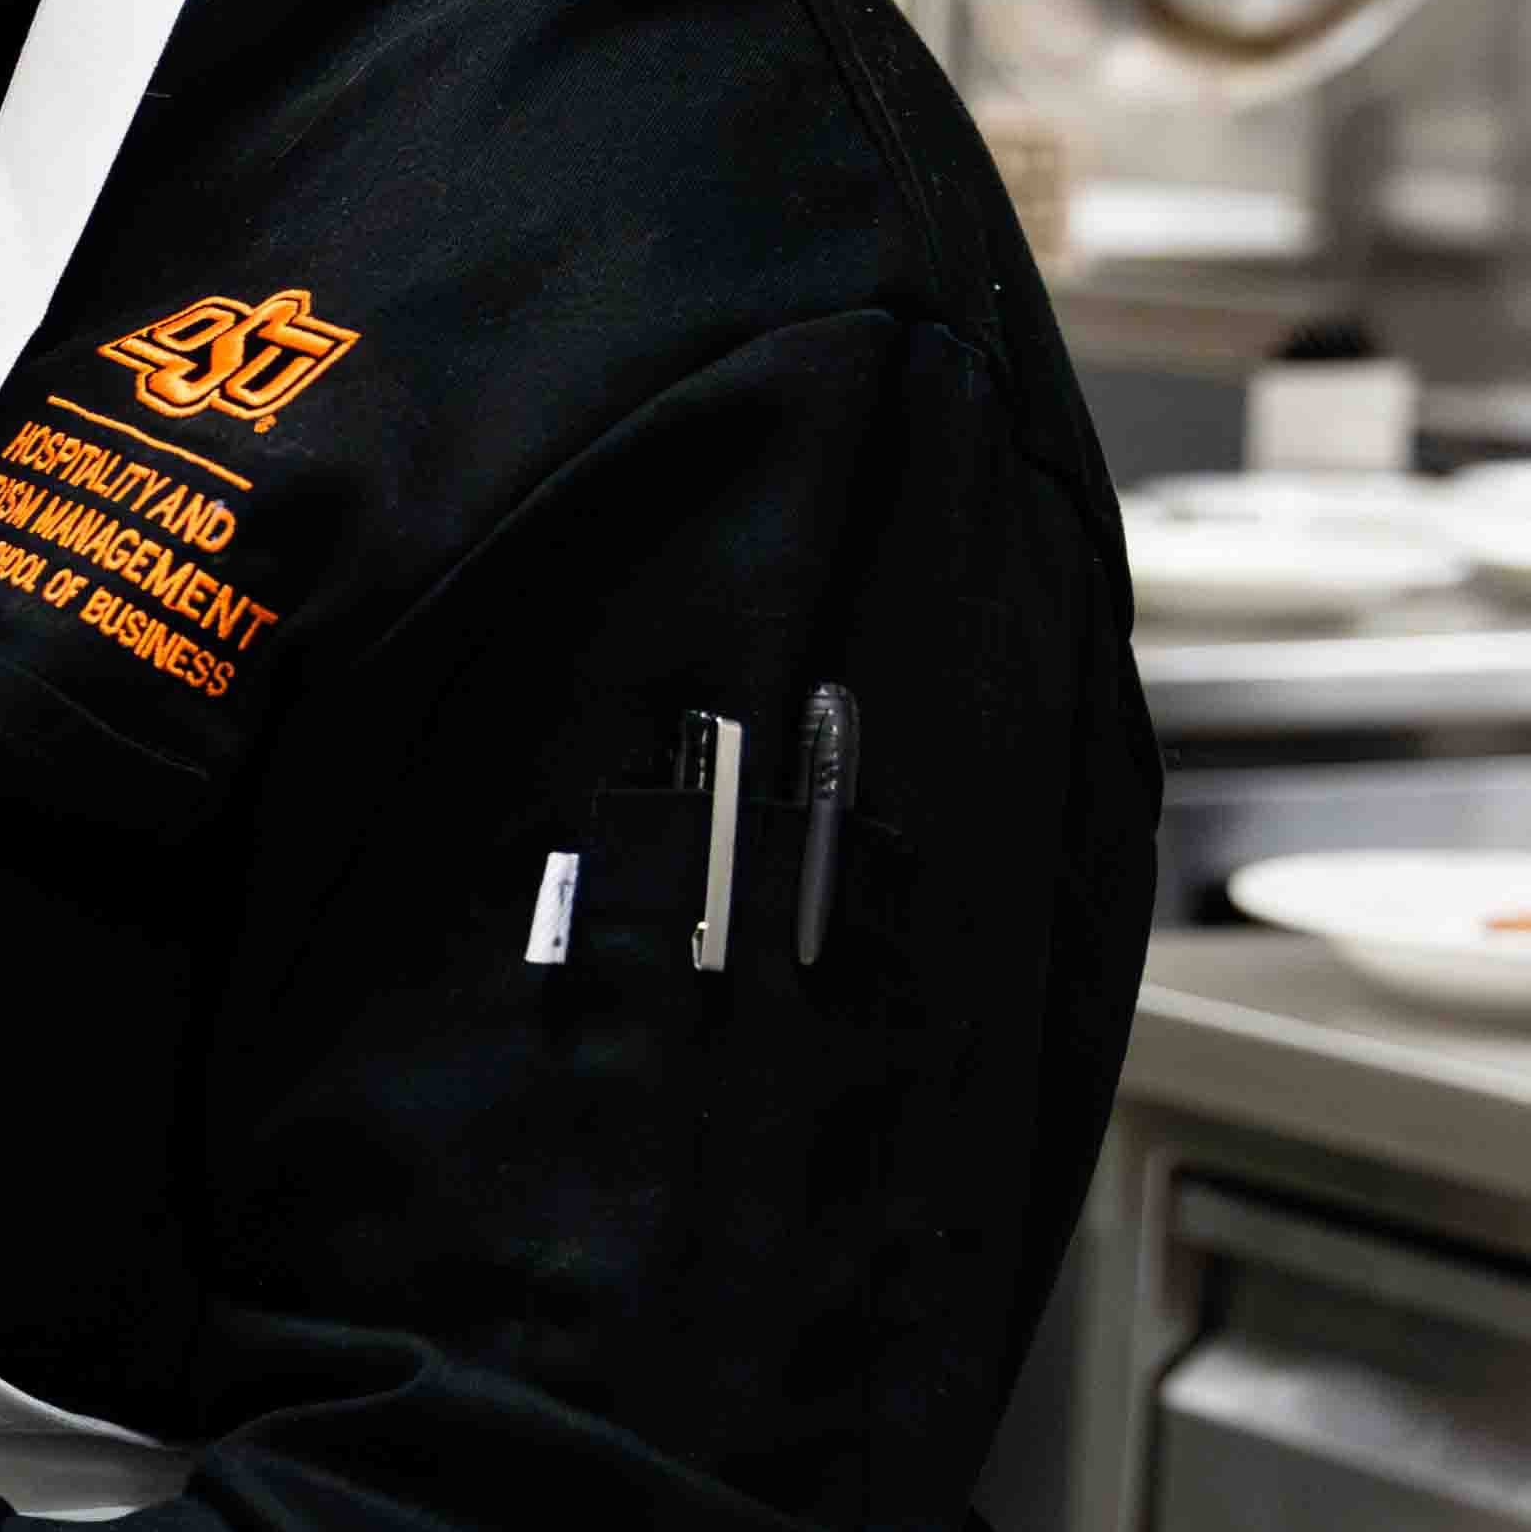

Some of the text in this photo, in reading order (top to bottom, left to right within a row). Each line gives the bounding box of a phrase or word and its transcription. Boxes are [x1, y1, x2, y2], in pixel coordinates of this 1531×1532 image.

[97, 289, 364, 418] OSU
[2, 420, 237, 553] HOSPITALITY AND
[28, 494, 278, 652] MANAGEMENT
[43, 567, 90, 609] OF
[79, 586, 235, 697] BUSINESS
